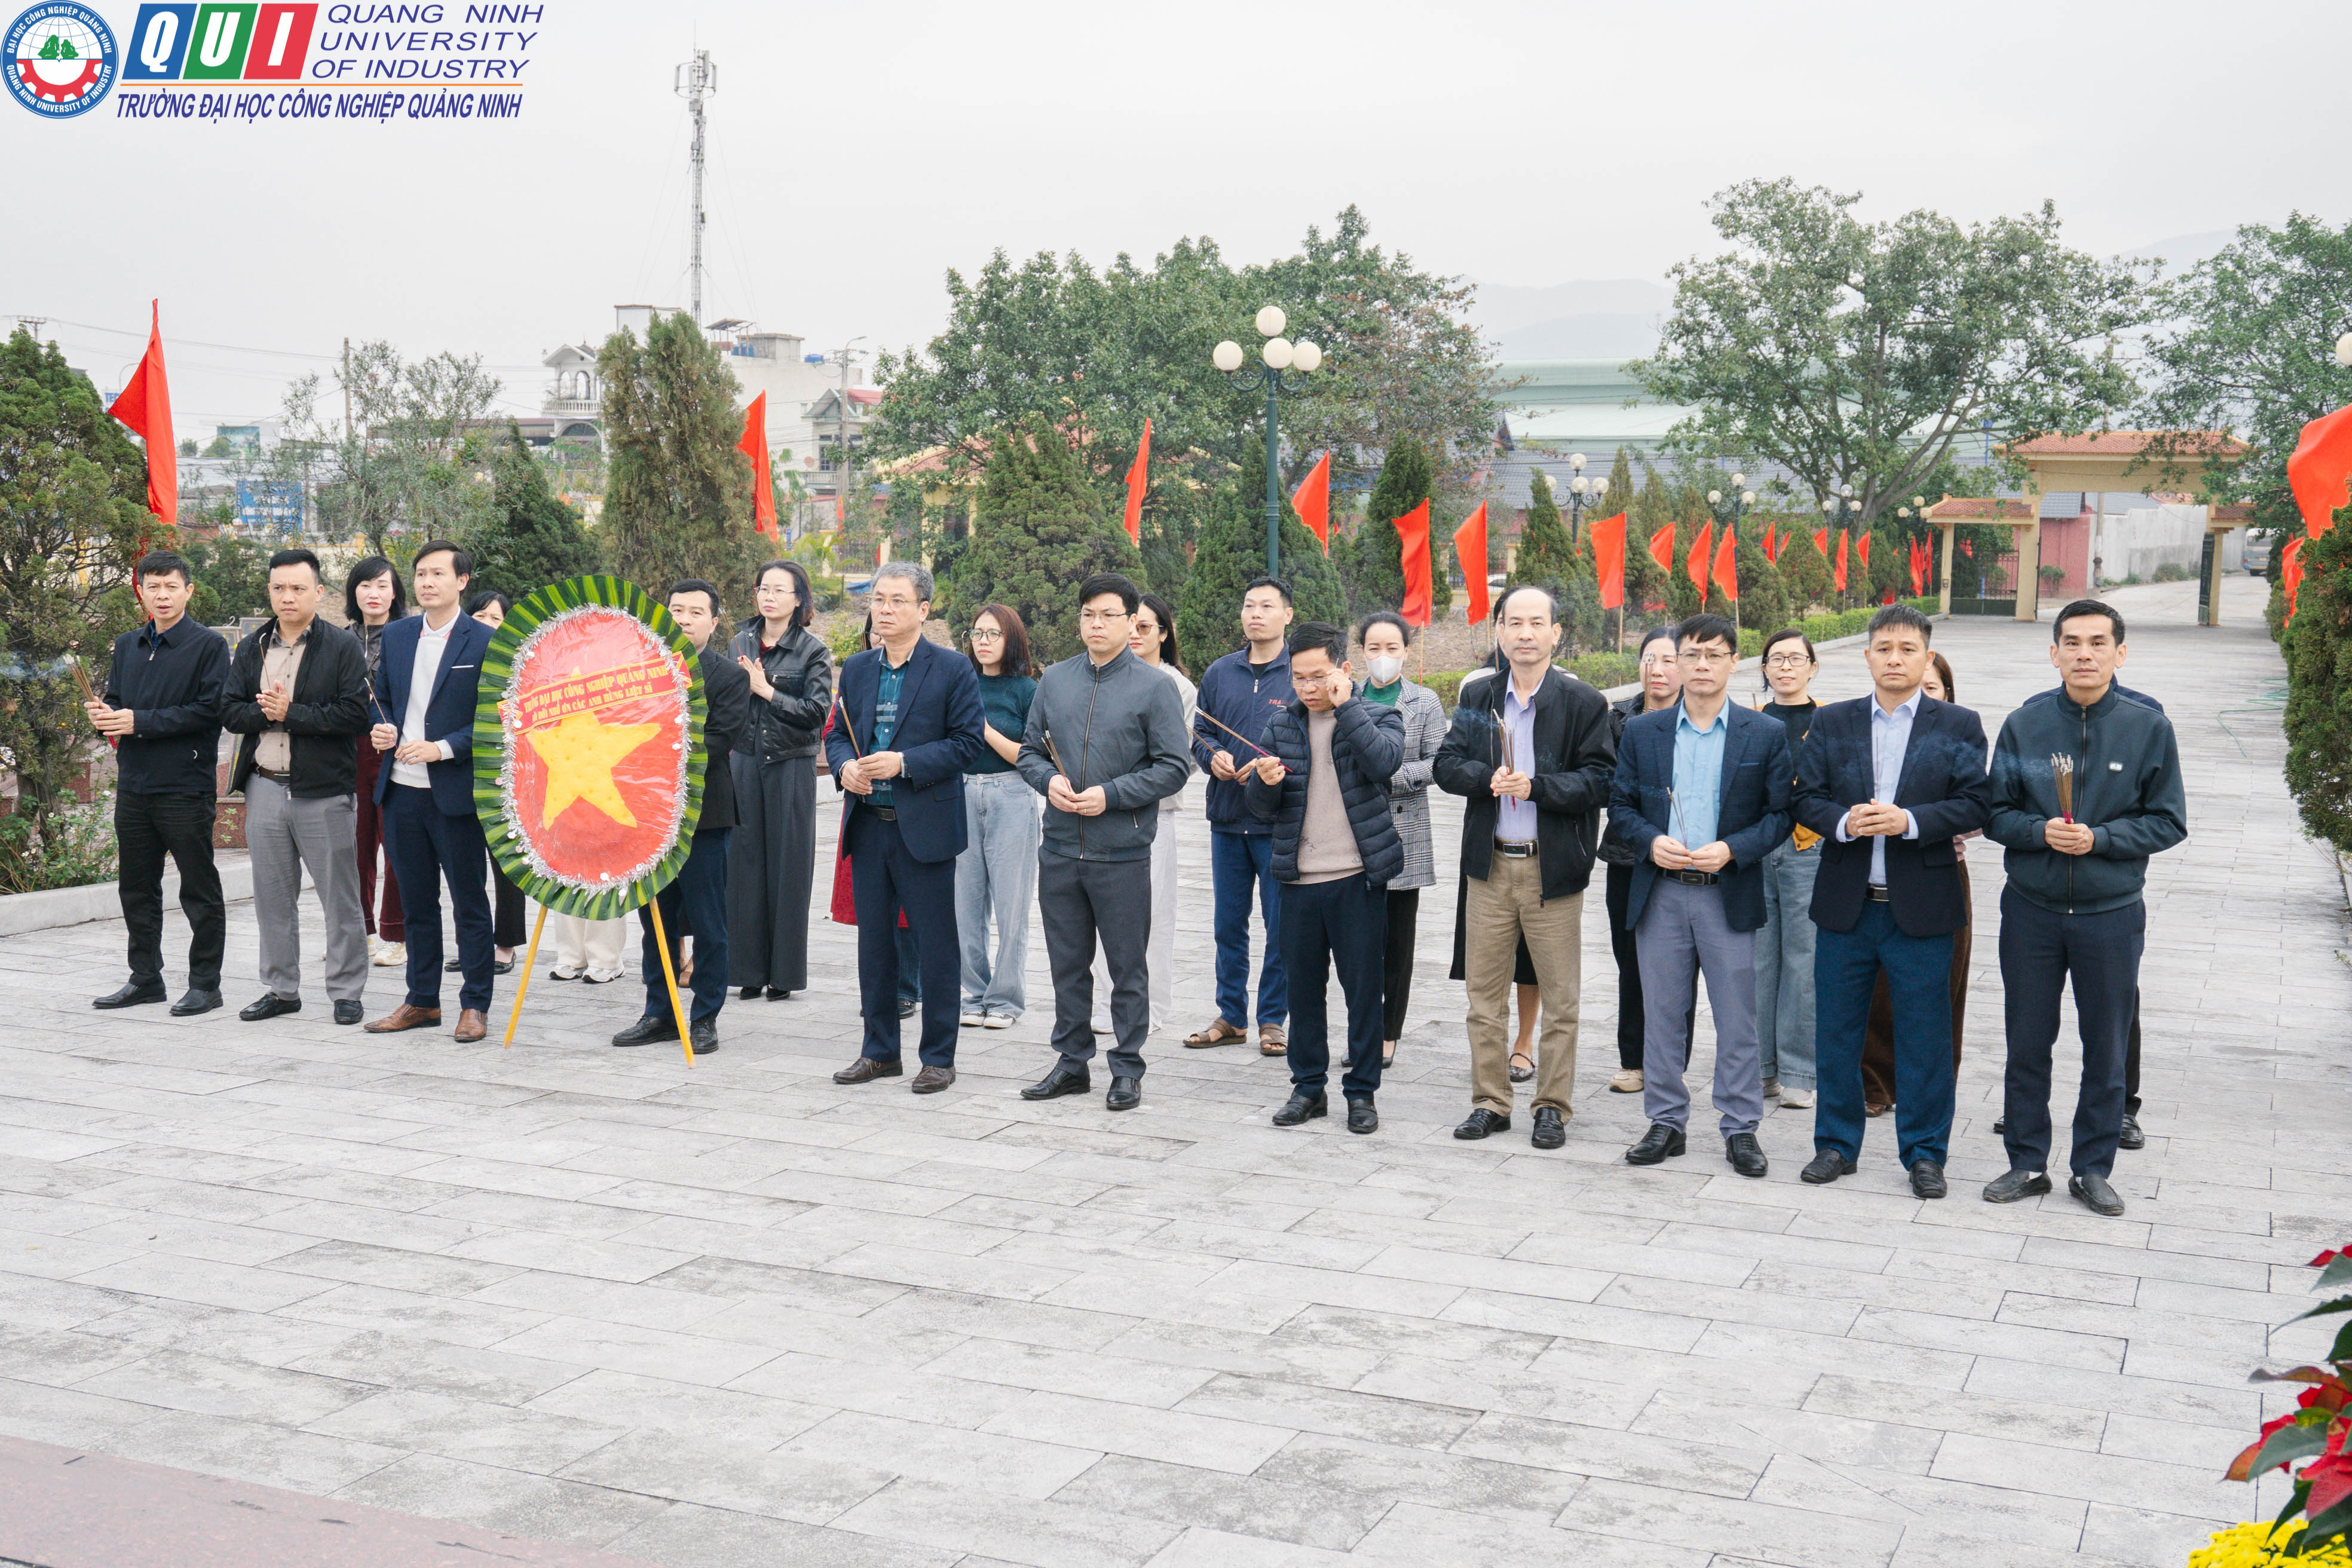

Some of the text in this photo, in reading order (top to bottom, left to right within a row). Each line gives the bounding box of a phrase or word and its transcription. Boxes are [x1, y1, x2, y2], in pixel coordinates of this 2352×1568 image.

[564, 683, 585, 699] CÔNG
[616, 666, 645, 687] QUẢNG
[646, 664, 668, 679] NINH
